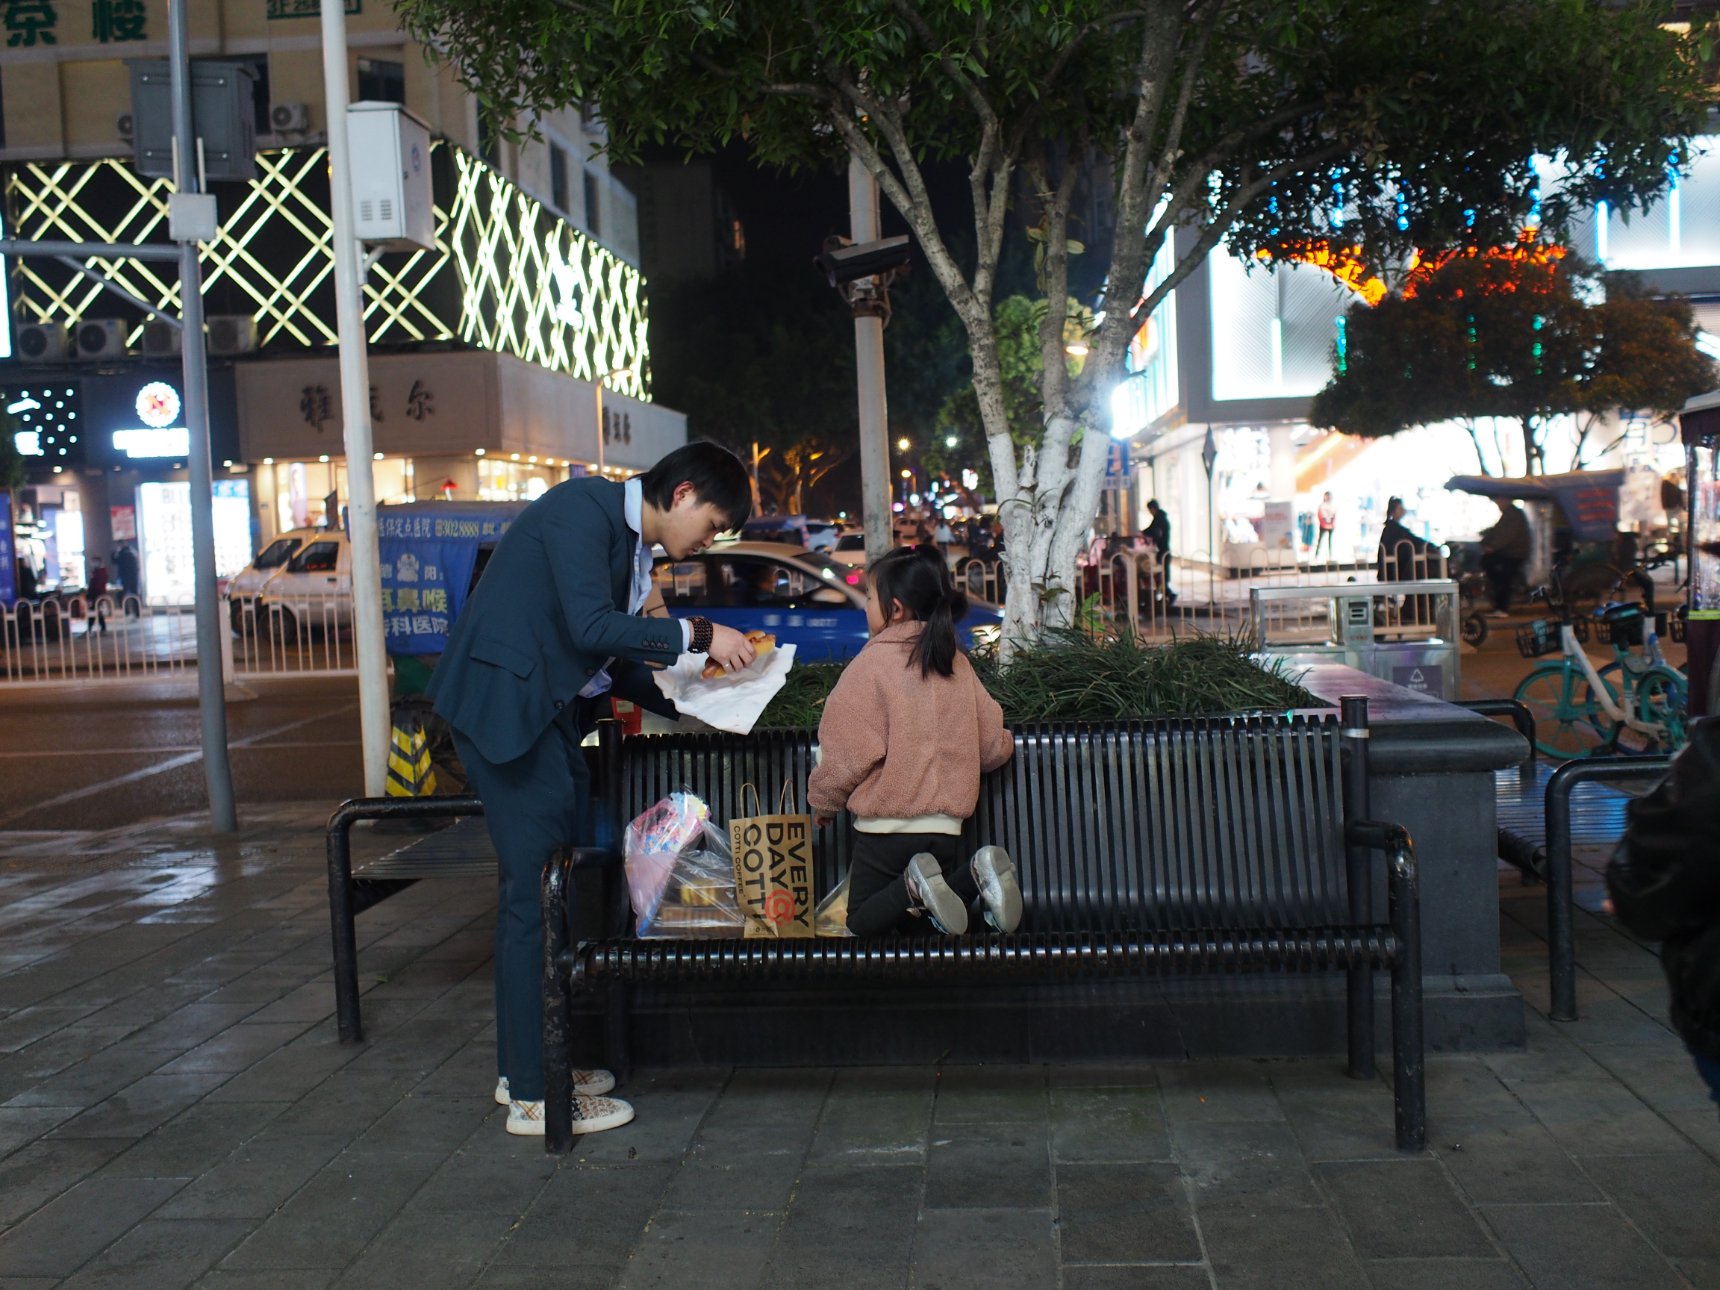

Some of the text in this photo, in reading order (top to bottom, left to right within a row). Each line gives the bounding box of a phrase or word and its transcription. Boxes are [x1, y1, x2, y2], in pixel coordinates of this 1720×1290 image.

[733, 825, 744, 894] COTTI COFFEE
[766, 823, 788, 889] DAY
[788, 823, 809, 928] EVERY
